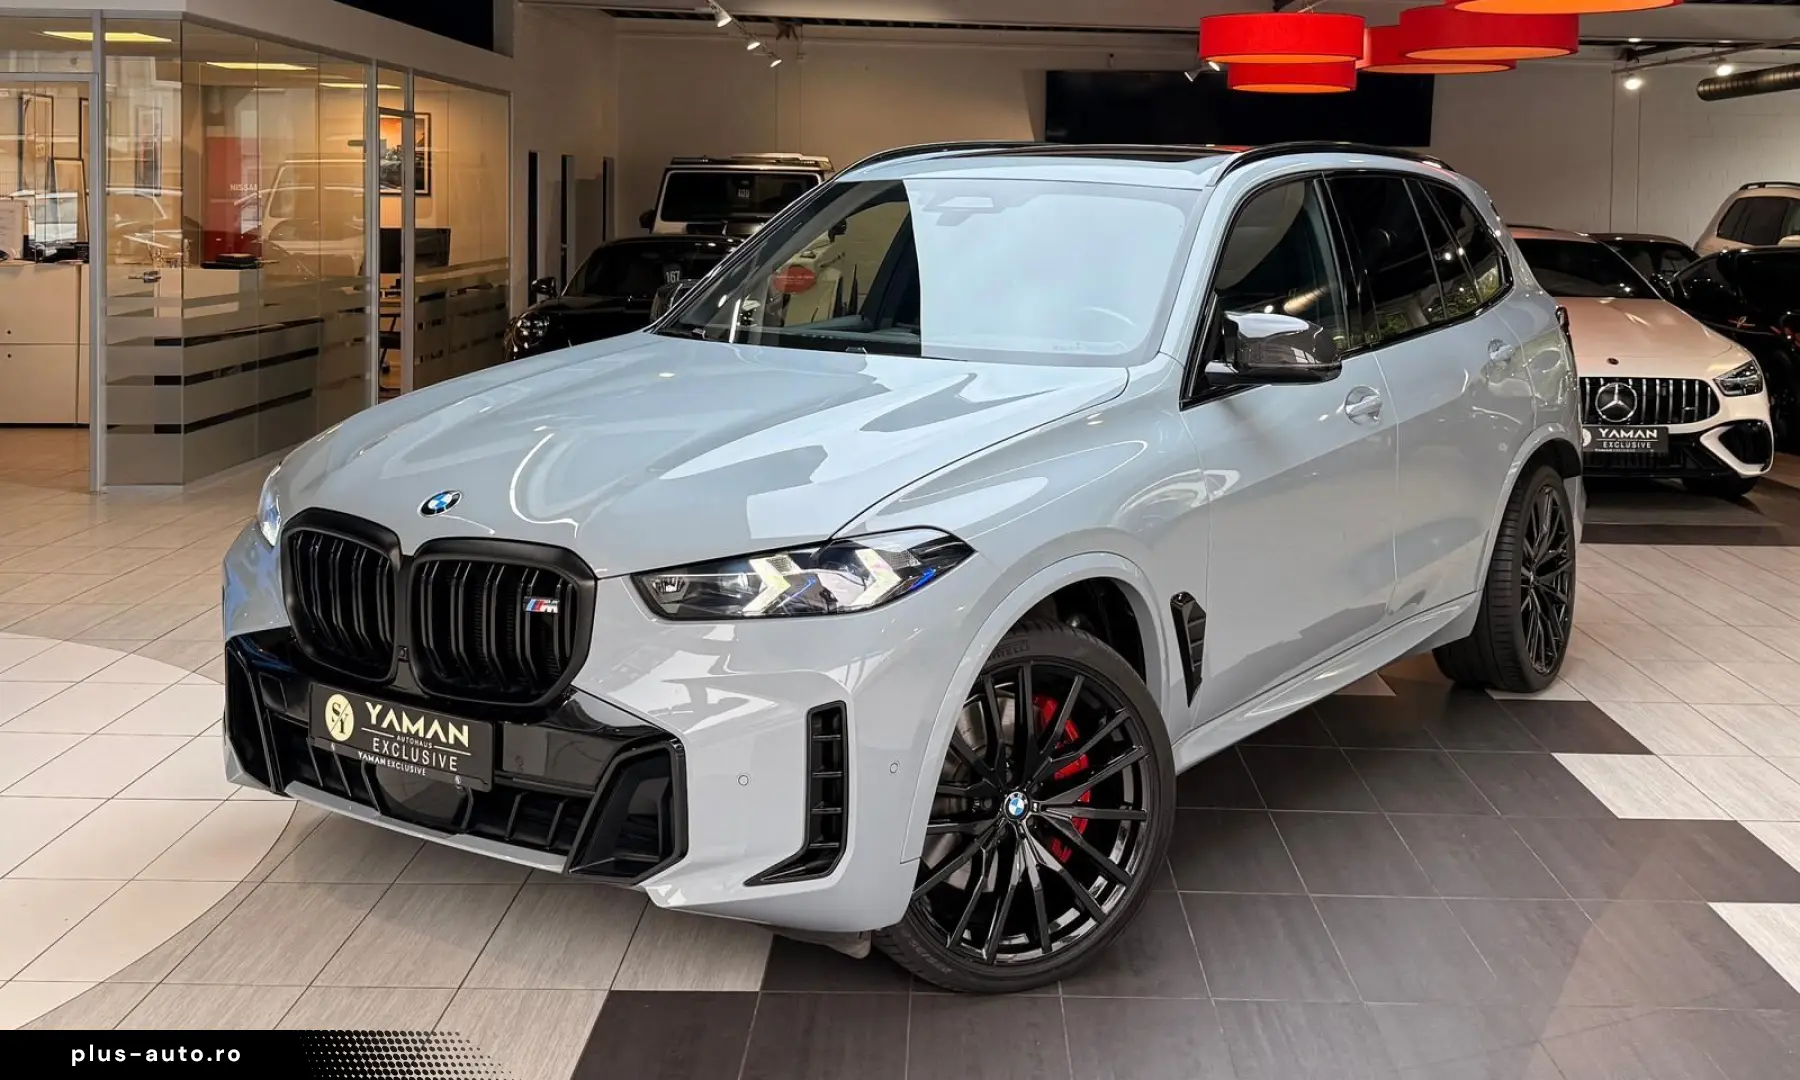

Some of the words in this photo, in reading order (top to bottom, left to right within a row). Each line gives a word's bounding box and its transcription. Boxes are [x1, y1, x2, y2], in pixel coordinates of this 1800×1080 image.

[1599, 428, 1657, 438] YAMAN
[1603, 441, 1651, 449] EXCLUSIVE
[365, 701, 469, 748] YAMAN
[396, 735, 433, 749] AUTOHAUS
[358, 751, 386, 766] YAMAN
[387, 759, 426, 776] EXCLUSIVE
[372, 737, 458, 772] EXCLUSIVE
